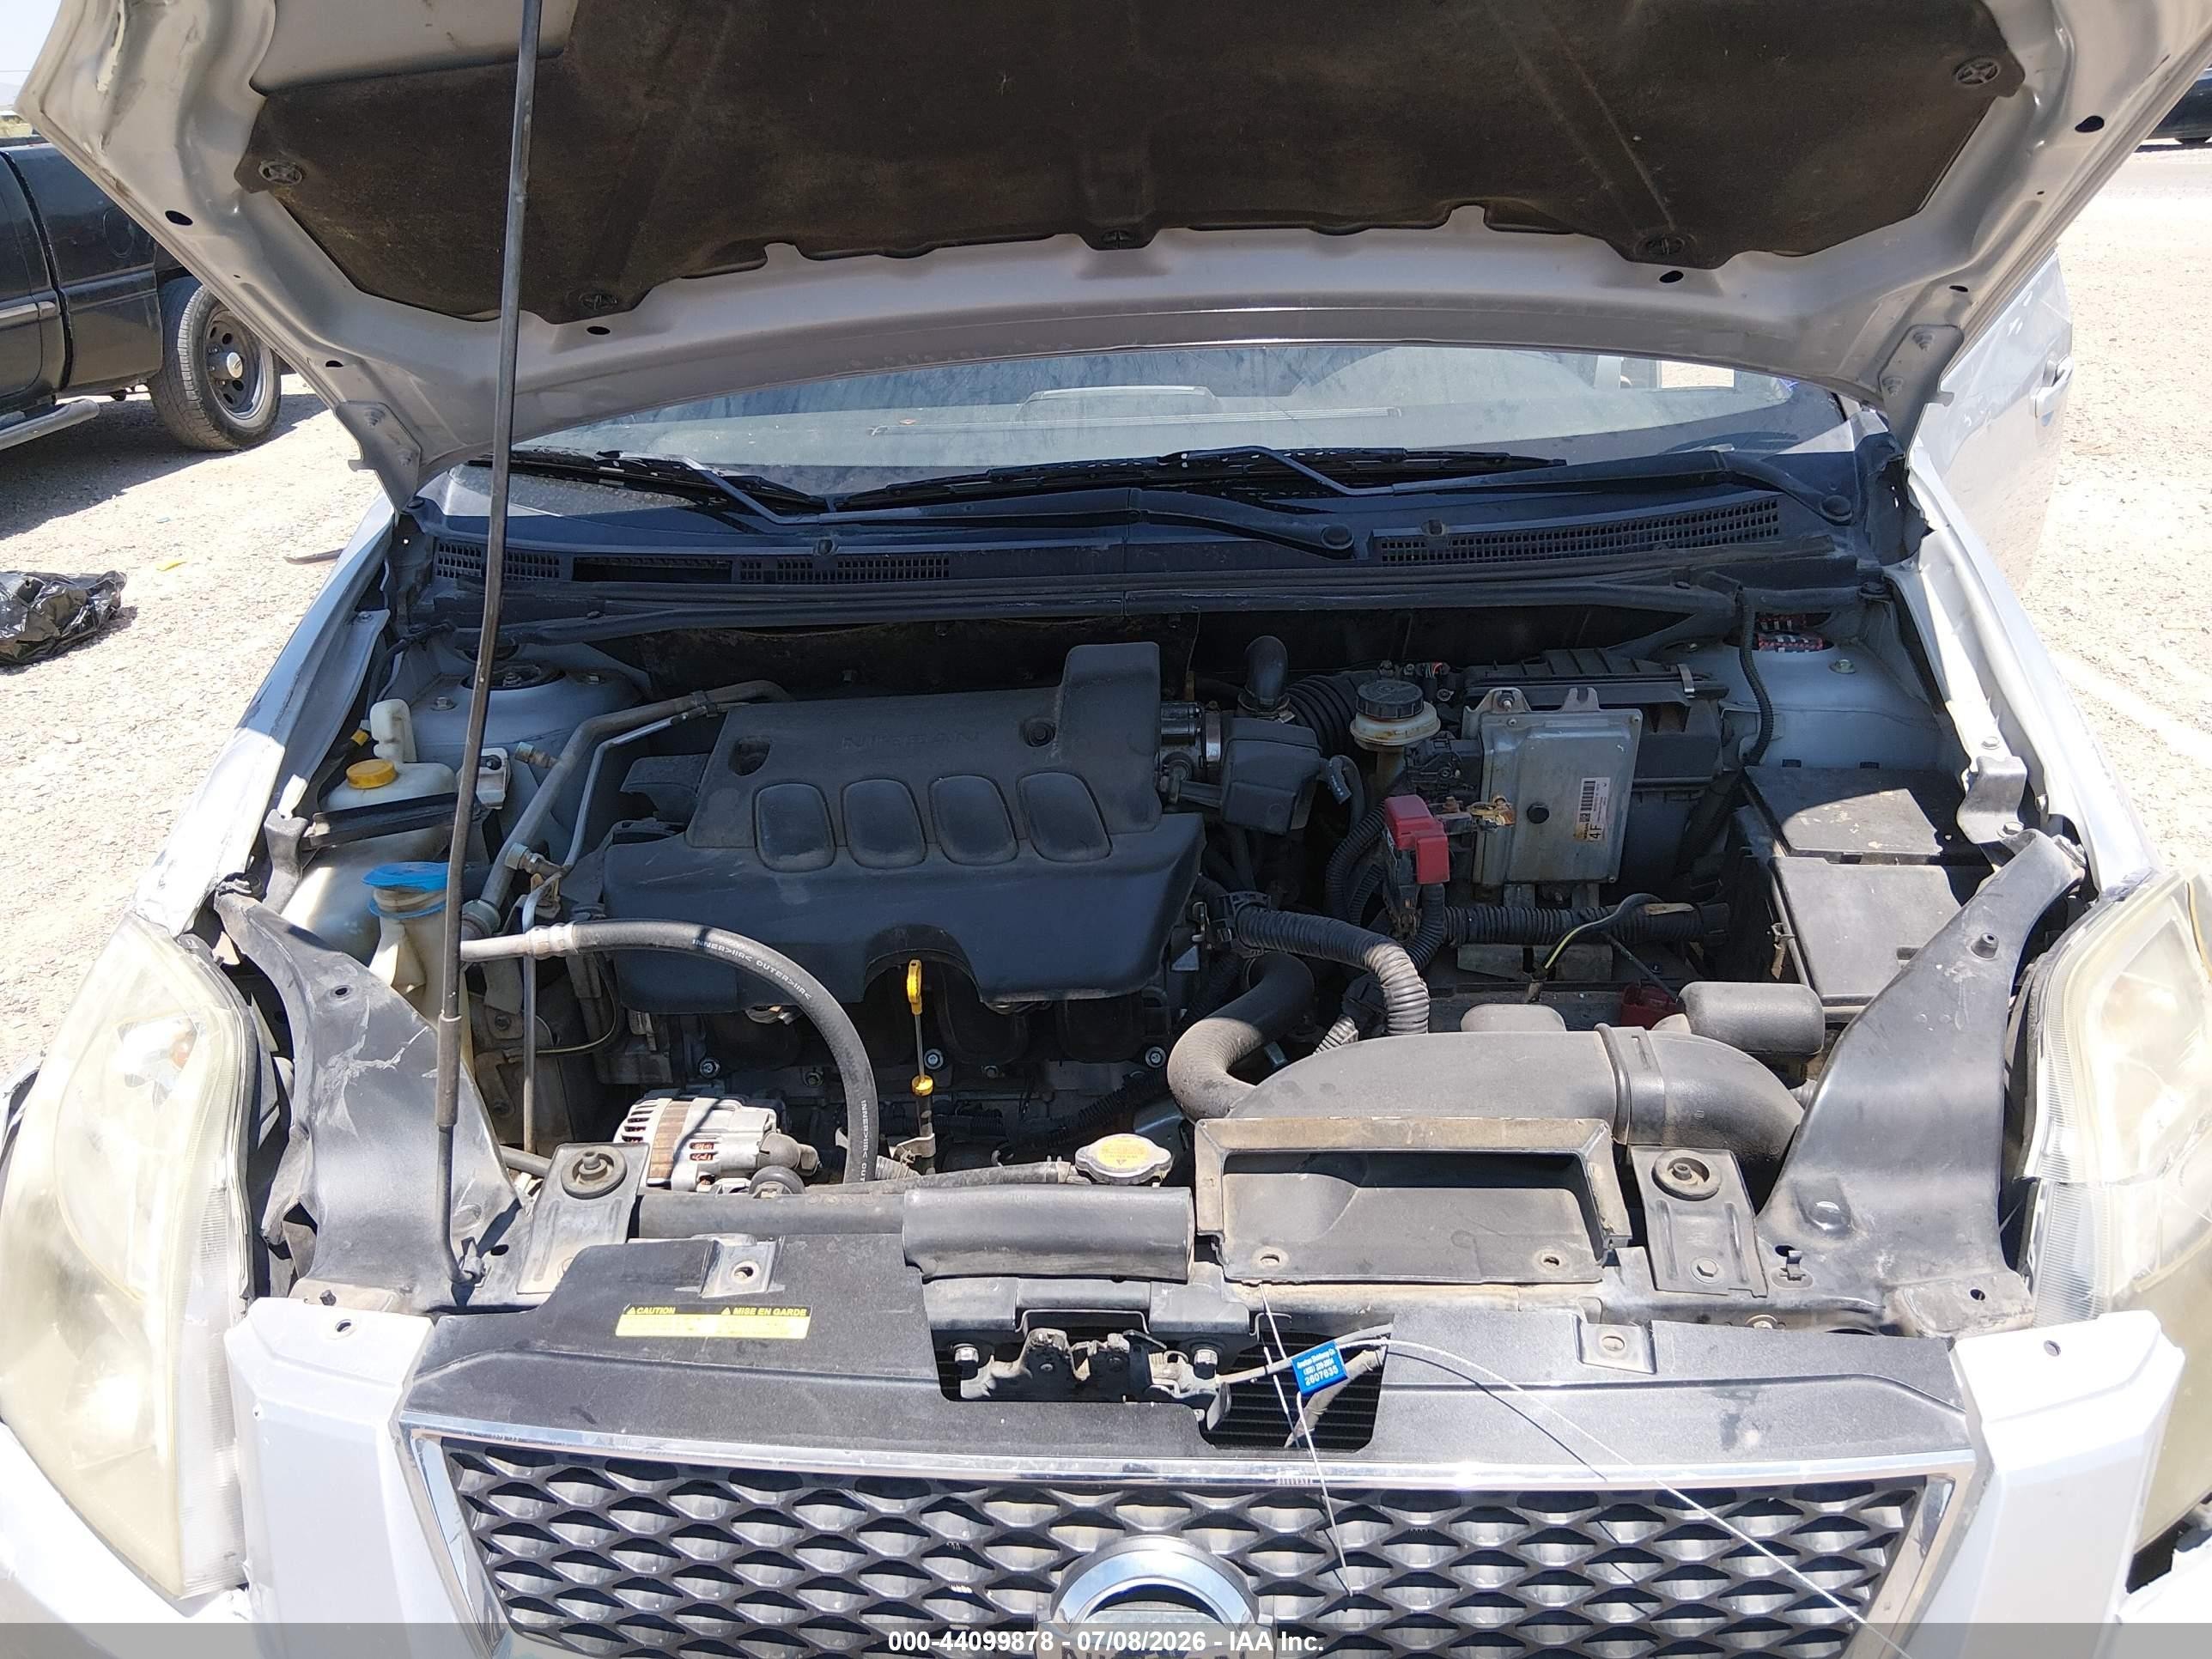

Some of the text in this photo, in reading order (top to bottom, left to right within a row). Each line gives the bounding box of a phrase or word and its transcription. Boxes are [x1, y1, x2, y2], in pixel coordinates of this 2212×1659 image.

[636, 1306, 677, 1315] CAUTION
[733, 1307, 757, 1316] MISE
[774, 1308, 806, 1316] GARDE
